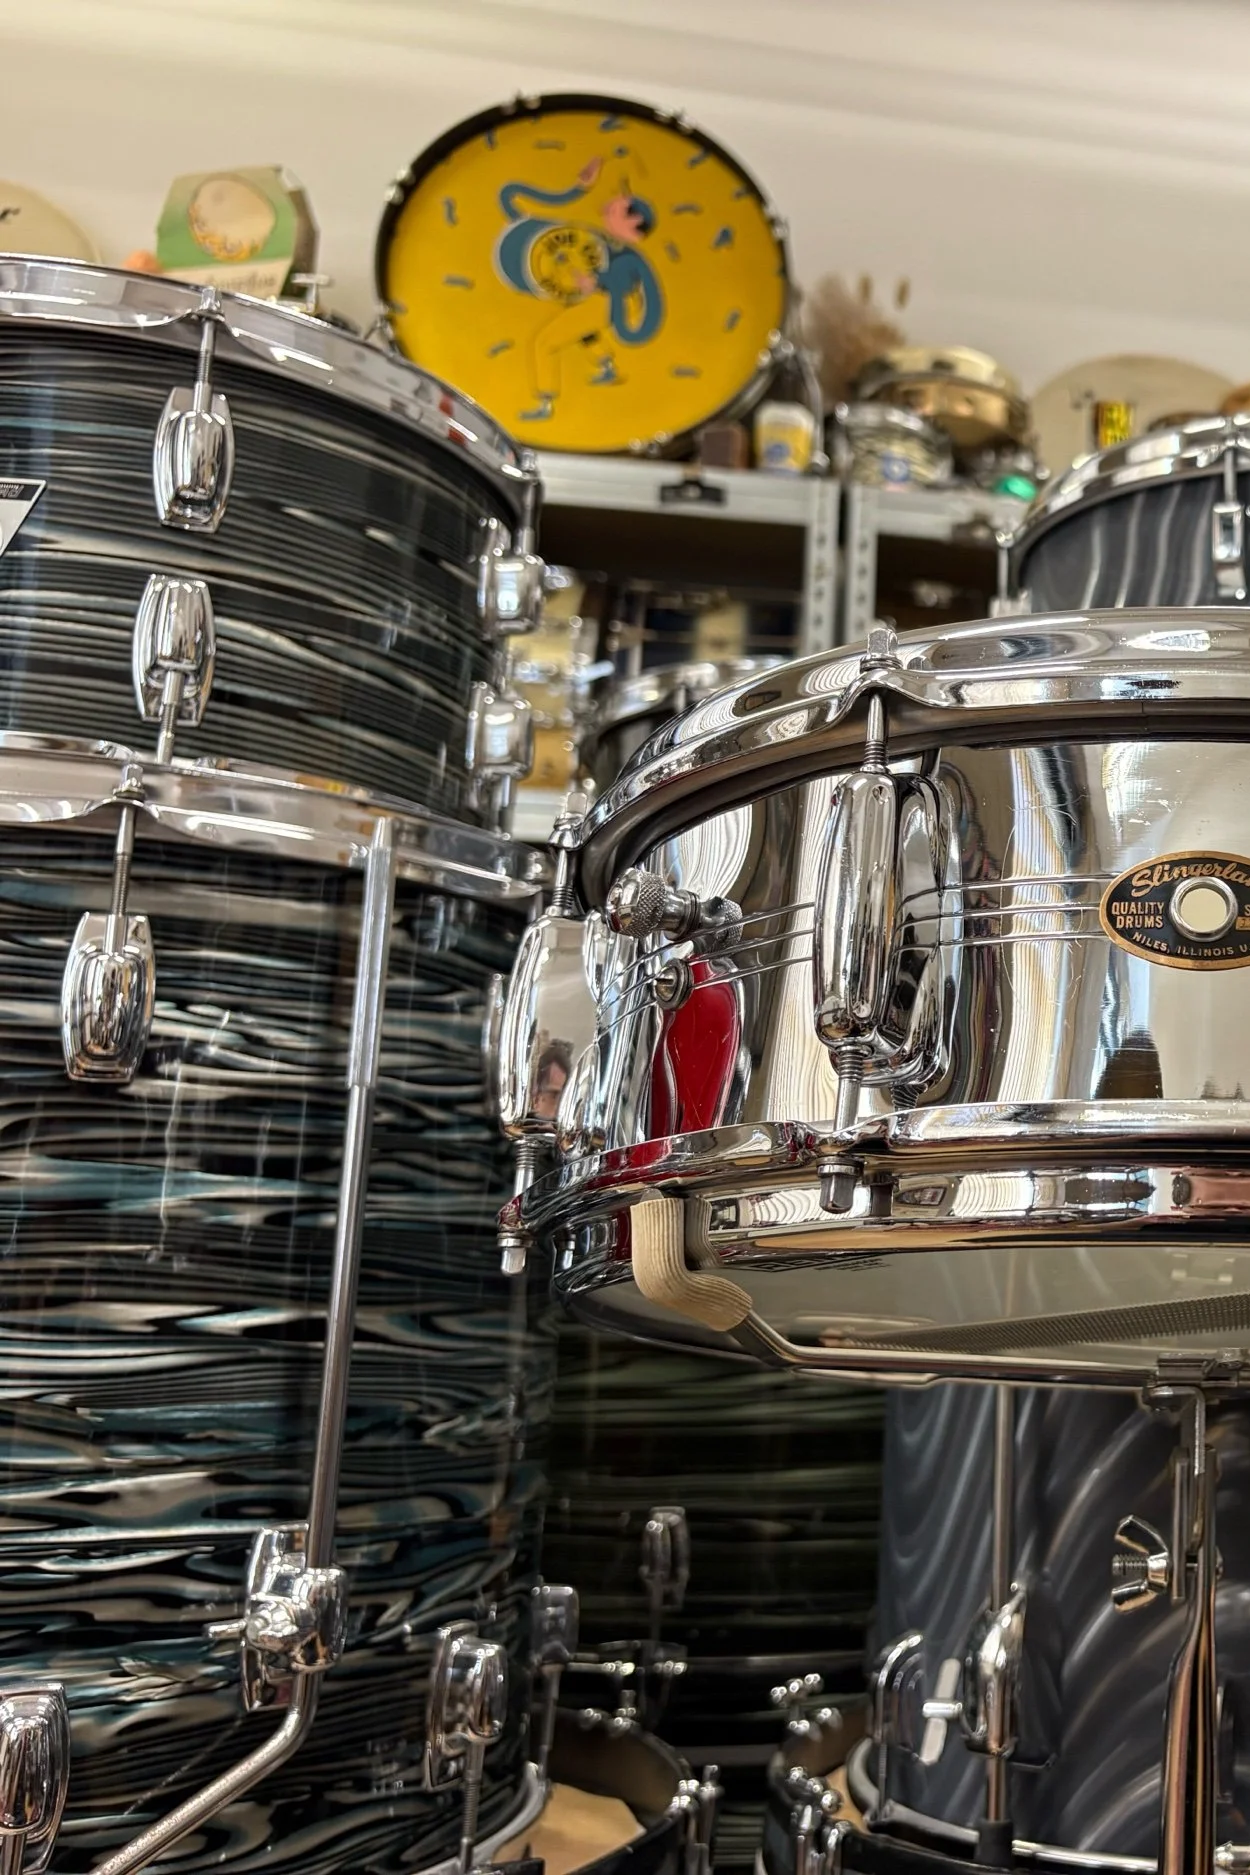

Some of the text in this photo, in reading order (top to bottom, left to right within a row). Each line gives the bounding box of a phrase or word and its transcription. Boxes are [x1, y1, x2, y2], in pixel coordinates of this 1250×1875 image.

[1111, 901, 1165, 915] QUALITY
[1116, 915, 1164, 928] DRUMS
[1132, 932, 1170, 954] NILES,
[1177, 946, 1235, 957] ILLINOIS
